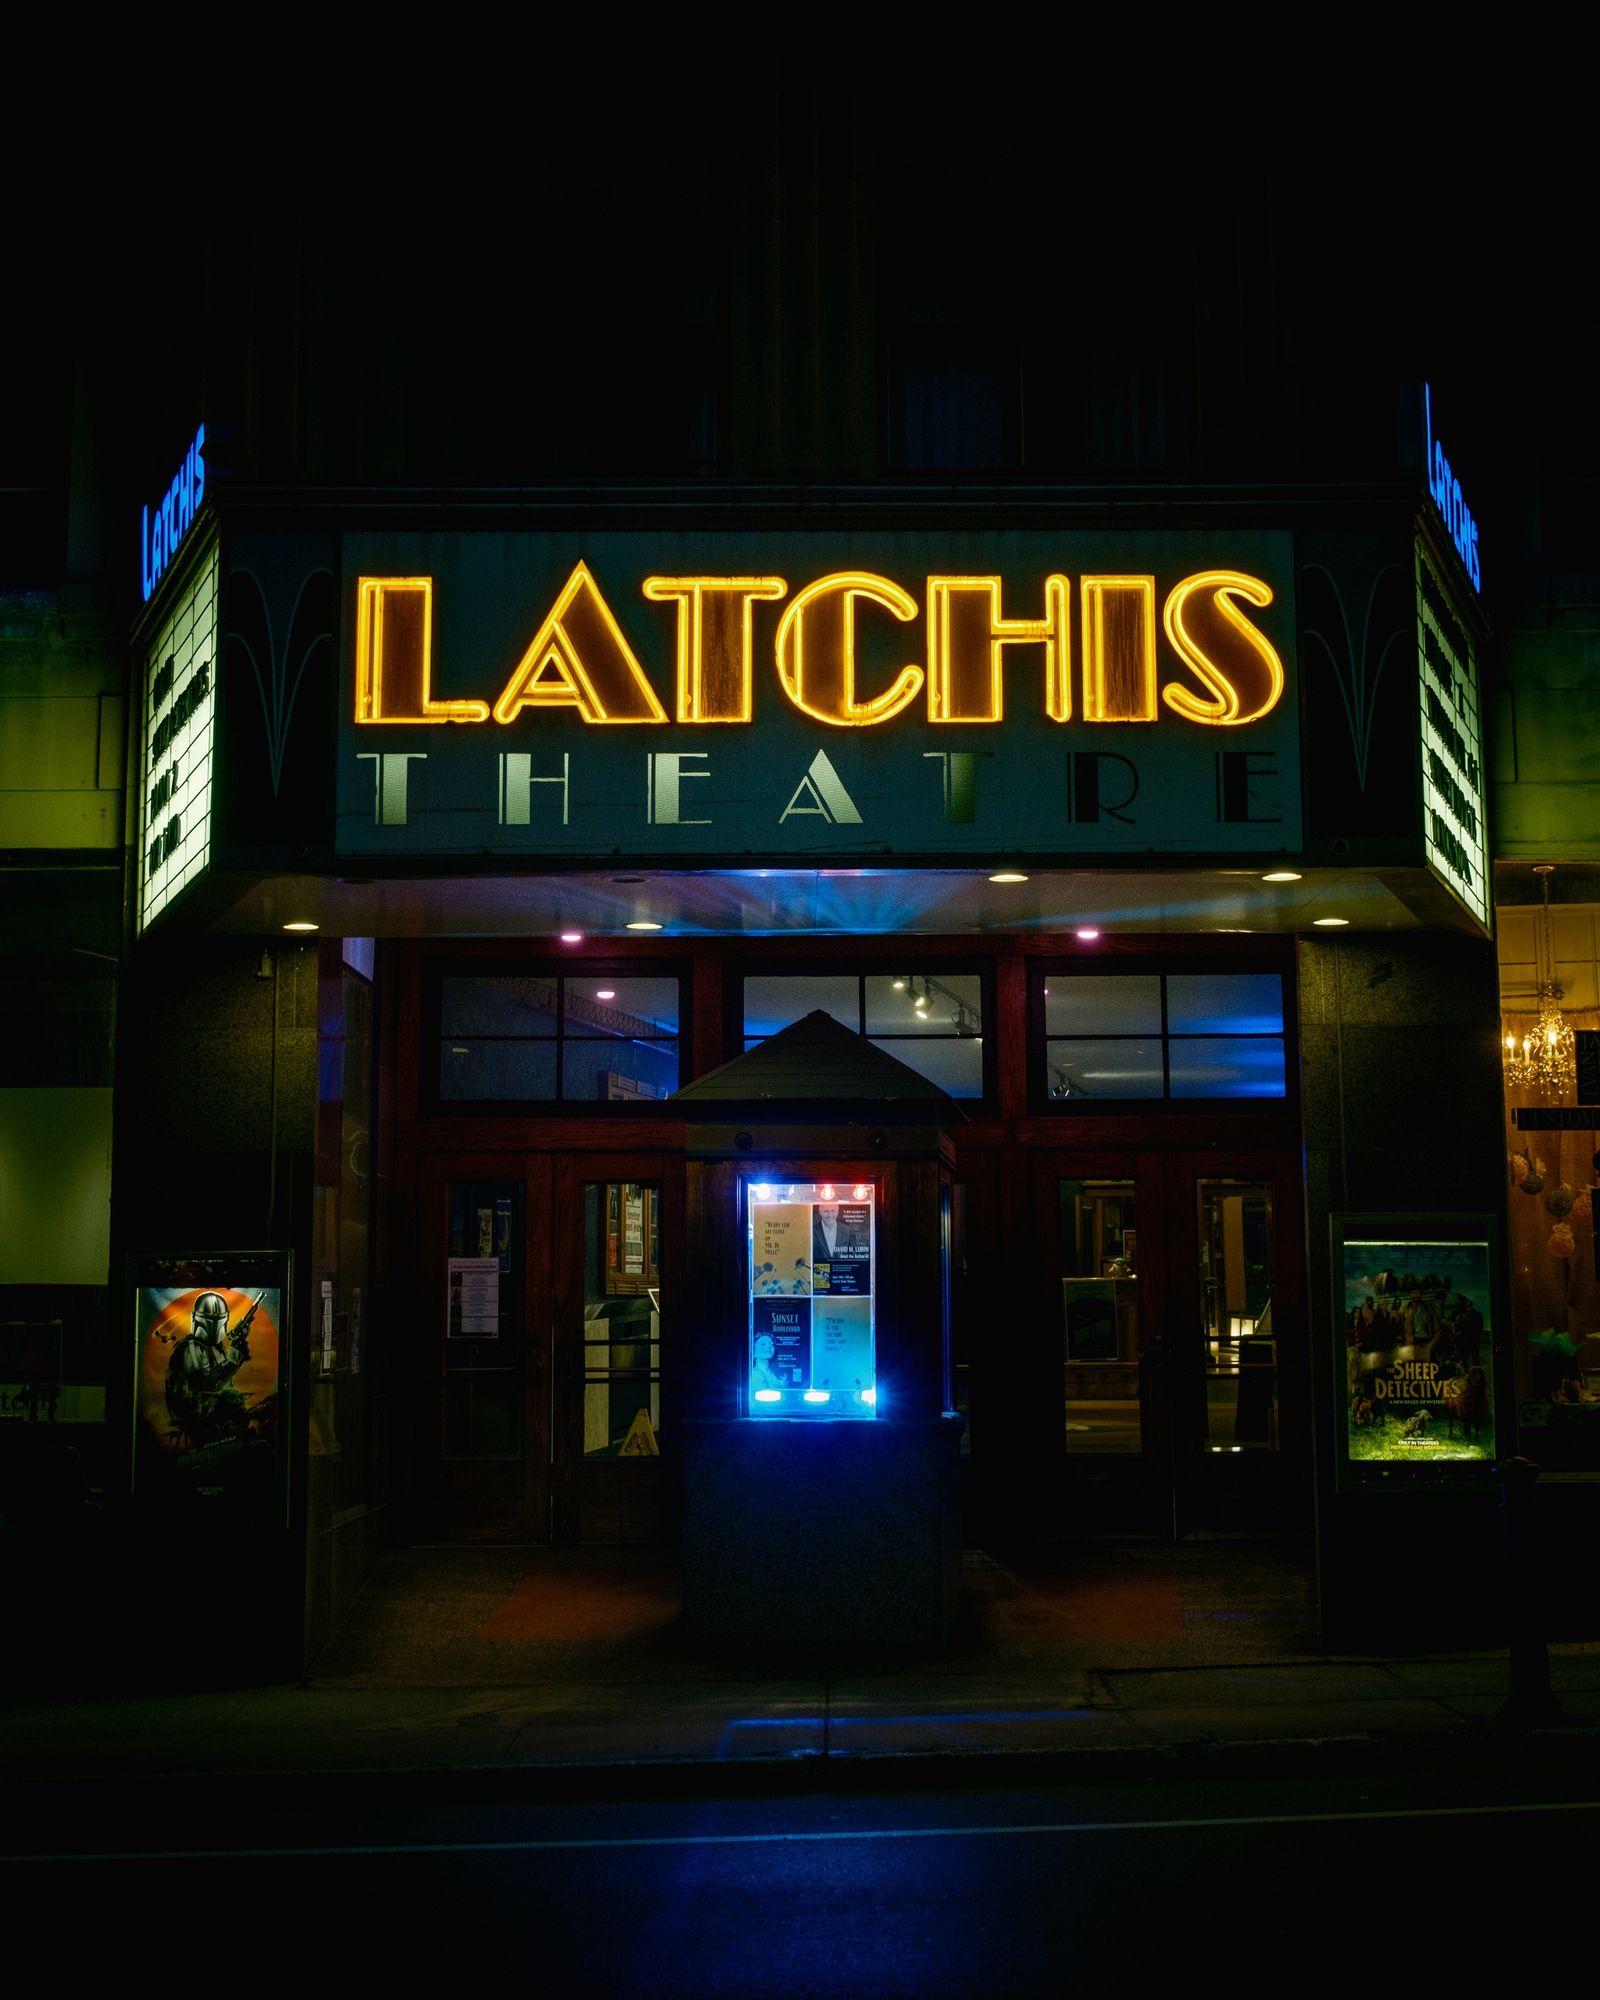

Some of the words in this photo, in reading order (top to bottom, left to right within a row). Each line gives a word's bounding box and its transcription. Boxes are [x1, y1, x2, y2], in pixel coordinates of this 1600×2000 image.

[142, 422, 205, 602] LATCHIS
[1424, 380, 1481, 594] LATCHIS
[353, 557, 1286, 728] LATCHIS
[355, 747, 1282, 827] THEATRE
[772, 1312, 799, 1324] SUNSET
[772, 1324, 801, 1333] BOULEVARD
[1375, 1377, 1463, 1399] DETECTIVES
[1393, 1359, 1439, 1380] SHEEP
